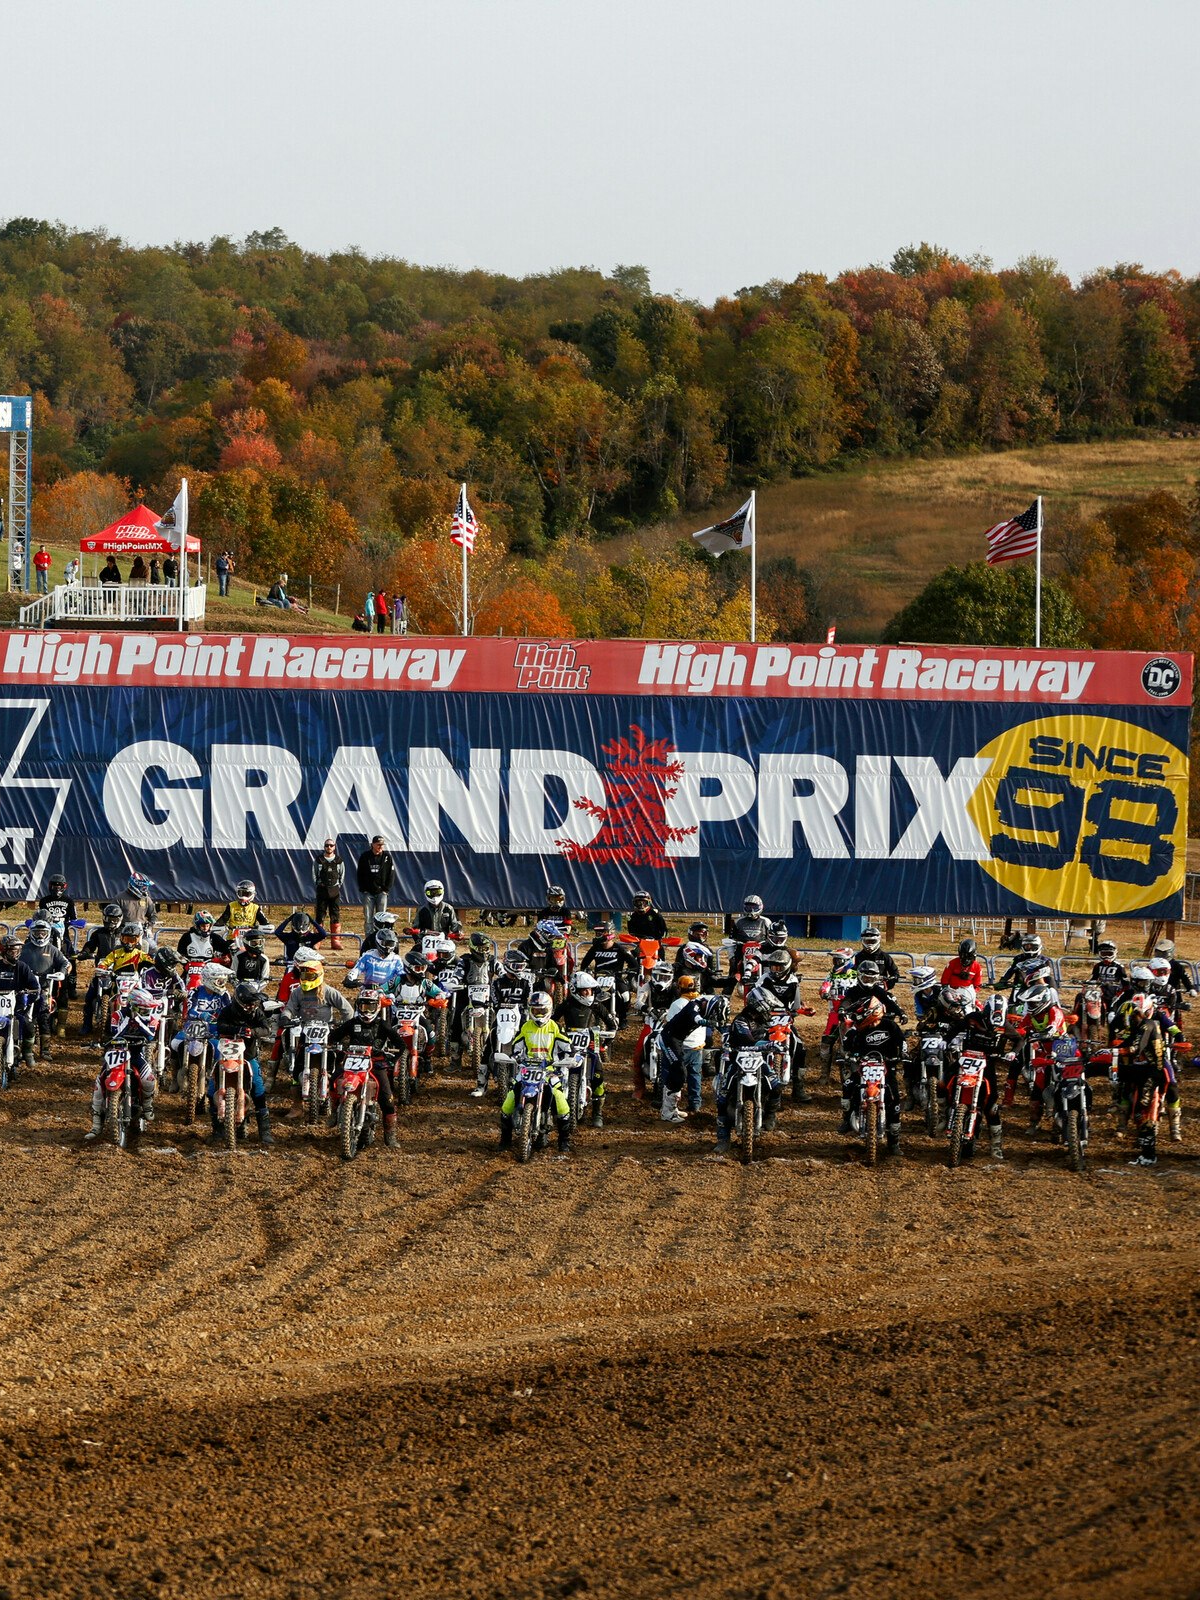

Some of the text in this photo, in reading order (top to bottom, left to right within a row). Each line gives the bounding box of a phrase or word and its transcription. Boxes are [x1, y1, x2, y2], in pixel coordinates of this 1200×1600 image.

[116, 525, 149, 534] High
[103, 542, 163, 551] #HighPointMX
[3, 633, 466, 688] High Point Raceway
[513, 642, 579, 670] High
[517, 664, 592, 691] Point
[638, 644, 1095, 700] High Point Raceway
[1148, 667, 1174, 690] DC
[1029, 735, 1170, 781] SINCE
[103, 740, 994, 861] GRAND PRIX
[990, 766, 1178, 886] 98
[49, 907, 66, 917] 805
[594, 951, 616, 959] THOR
[501, 988, 523, 996] TLD
[197, 1000, 225, 1011] FXR
[397, 1011, 418, 1020] 537
[500, 1014, 517, 1023] 119
[769, 1016, 789, 1026] 34
[307, 1028, 327, 1039] 168
[224, 1043, 239, 1056] 3
[107, 1051, 127, 1065] 179
[344, 1058, 370, 1070] 624
[962, 1059, 983, 1071] 84
[523, 1071, 544, 1082] 910
[862, 1066, 885, 1081] 355
